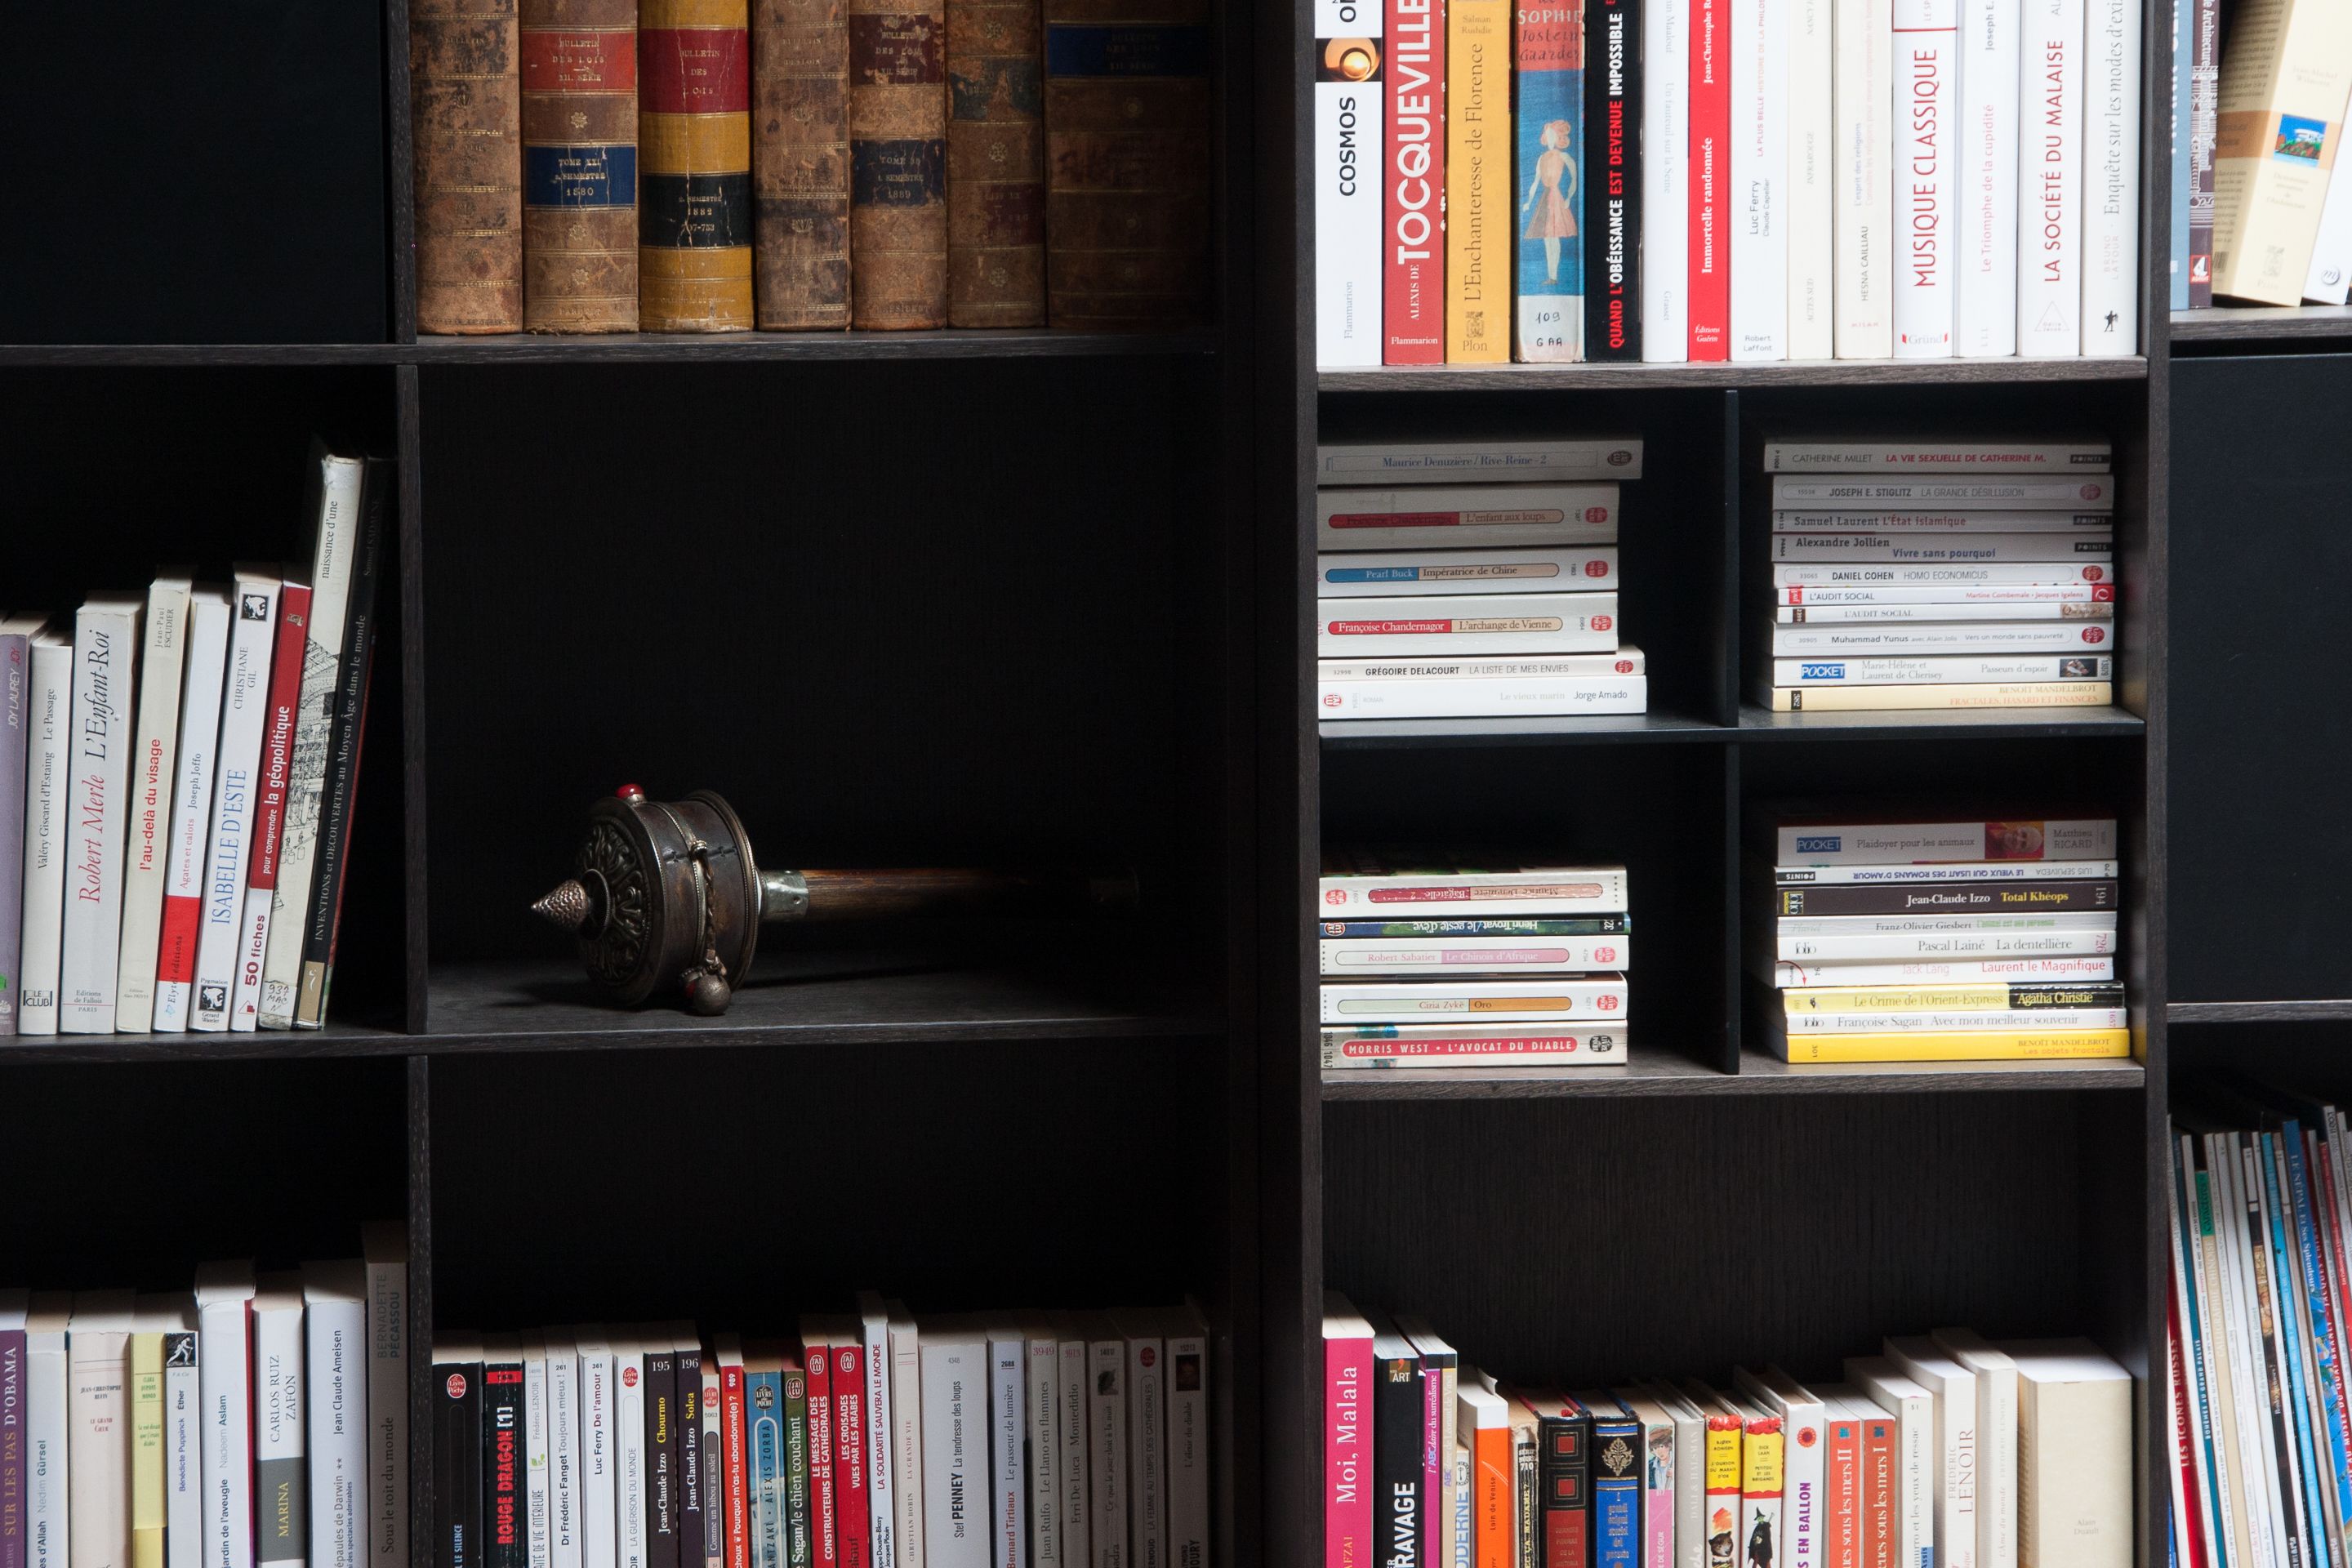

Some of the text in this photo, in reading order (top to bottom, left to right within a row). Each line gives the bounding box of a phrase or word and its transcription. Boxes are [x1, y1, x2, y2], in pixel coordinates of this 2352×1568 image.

[1462, 26, 1491, 34] Rushdie
[1703, 11, 1714, 83] Jean-Christophe
[691, 68, 707, 76] DES
[1339, 96, 1356, 197] COSMOS
[1398, 0, 1431, 264] TOCQUEVILLE
[2104, 42, 2125, 215] Enquête sur les modes
[1465, 42, 1484, 301] L'Enchanteresse de Florence
[1606, 13, 1624, 348] QUAND L'OBÉISSANCE EST DEVENUE IMPOSSIBLE
[1913, 49, 1939, 287] MUSIQUE CLASSIQUE
[2040, 40, 2064, 282] LA SOCIÉTÉ DU MALAISE
[1701, 138, 1713, 274] Immortelle randonnée
[1749, 180, 1762, 234] Luc Ferry
[1343, 281, 1354, 340] Flammarion
[1411, 264, 1420, 320] ALEXIS DE
[1391, 336, 1438, 345] Flammarion
[1462, 339, 1488, 352] Plon
[1793, 454, 2047, 463] CATHERINE MILLET LA VIE SEXUELLE DE CATHERINE M.
[322, 501, 338, 578] naissance d'une
[1797, 537, 1890, 548] Alexandre Jollien
[1892, 548, 1995, 559] Vivre sans pourquoi
[1365, 568, 1414, 578] Pearl Buck
[1832, 572, 1895, 581] DANIEL COHEN
[1339, 620, 1552, 634] Françoise Chandernagor L'archange de Vienne
[83, 629, 114, 761] L'Enfant-Roi
[234, 647, 248, 709] CHRISTIANE
[248, 670, 256, 688] GIL
[1365, 664, 1569, 676] GRÉGOIRE DELACOURT LA LISTE DE MES ENVIES
[1802, 665, 1844, 678] POCKET
[1574, 689, 1628, 702] Jorge Amado
[140, 739, 162, 871] l'au-delà du visage
[188, 753, 202, 808] Joseph Joffo
[263, 706, 292, 875] pour comprendre la géopolitique
[78, 774, 105, 903] Robert Merle
[211, 769, 247, 924] ISABELLE D'ESTE
[1797, 840, 1840, 851] POCKET
[1906, 891, 2069, 907] Jean-Claude Izzo Total Khéops
[245, 915, 265, 987] 50 fiches
[1918, 938, 2072, 951] Pascal Lainé La dentellière
[1981, 960, 2105, 973] Laurent le Magnifique
[25, 997, 49, 1007] CLUB
[2018, 991, 2093, 1004] Agatha Christie
[1349, 1040, 1572, 1054] MORRIS WEST L'AVOCAT DU DIABLE
[333, 1330, 341, 1374] Ameisen
[653, 1361, 670, 1371] 195
[681, 1359, 699, 1369] 196
[873, 1344, 881, 1377] MONDE
[270, 1355, 280, 1442] CARLOS RUIZ
[286, 1375, 296, 1420] ZAFÓN
[1392, 1373, 1410, 1382] ART
[219, 1395, 227, 1426] Aslam
[594, 1414, 601, 1427] De
[657, 1397, 666, 1443] Chourmo
[686, 1393, 694, 1419] Solea
[5, 1347, 16, 1535] SUR LES PAS D'OBAMA
[595, 1431, 604, 1455] Ferry
[789, 1417, 800, 1471] couchant
[1336, 1367, 1359, 1503] Moi, Malala
[497, 1432, 514, 1544] ROUGE DRAGON
[687, 1450, 699, 1511] Jean-Claude
[951, 1417, 964, 1538] Stef PENNEY tendresse
[1959, 1429, 1973, 1512] LENOIR
[279, 1482, 288, 1537] MARINA
[822, 1481, 833, 1559] CONSTRUCTEURS
[1798, 1482, 1811, 1553] EN BALLON
